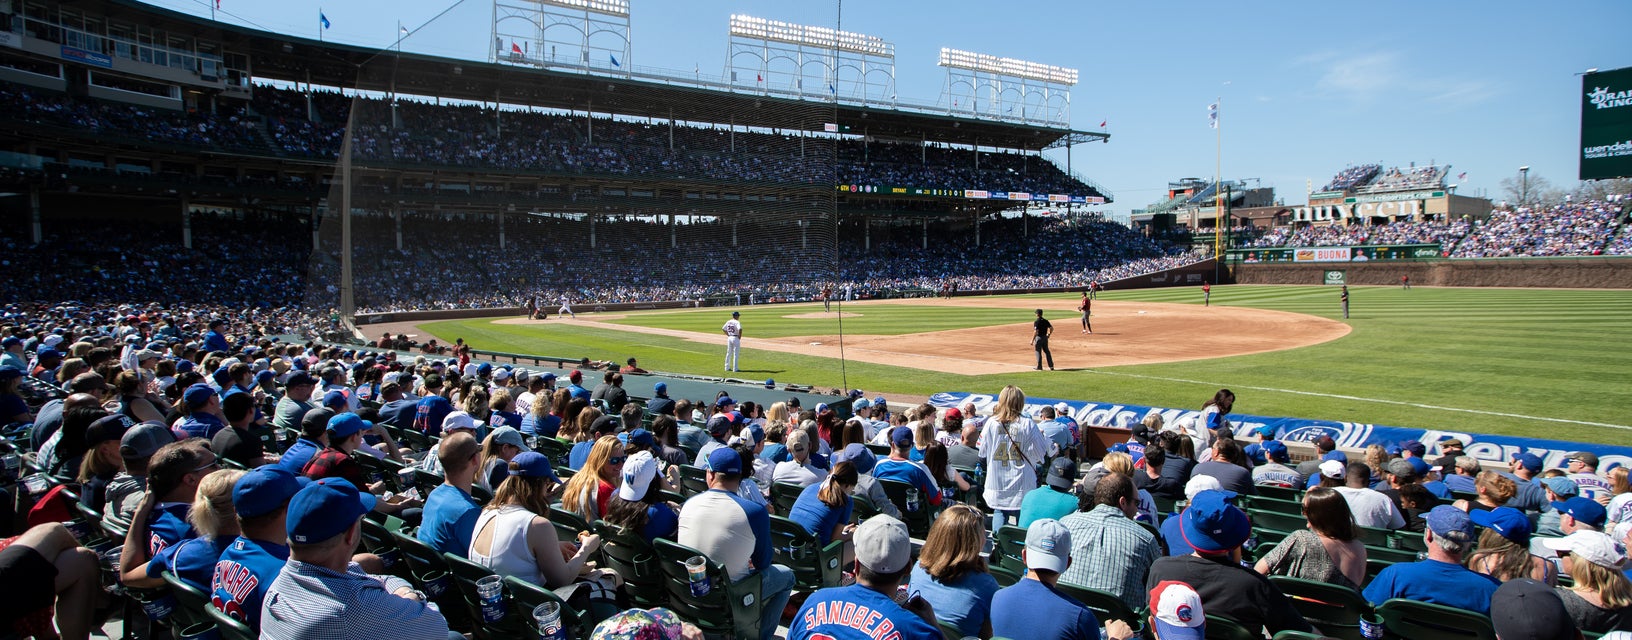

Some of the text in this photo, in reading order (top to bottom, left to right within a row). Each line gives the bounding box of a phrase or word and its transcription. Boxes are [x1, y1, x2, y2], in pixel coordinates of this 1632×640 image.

[1293, 201, 1420, 222] nuveen
[1317, 249, 1347, 260] BUONA
[727, 325, 736, 333] 25
[994, 441, 1022, 467] 44
[625, 473, 635, 485] W
